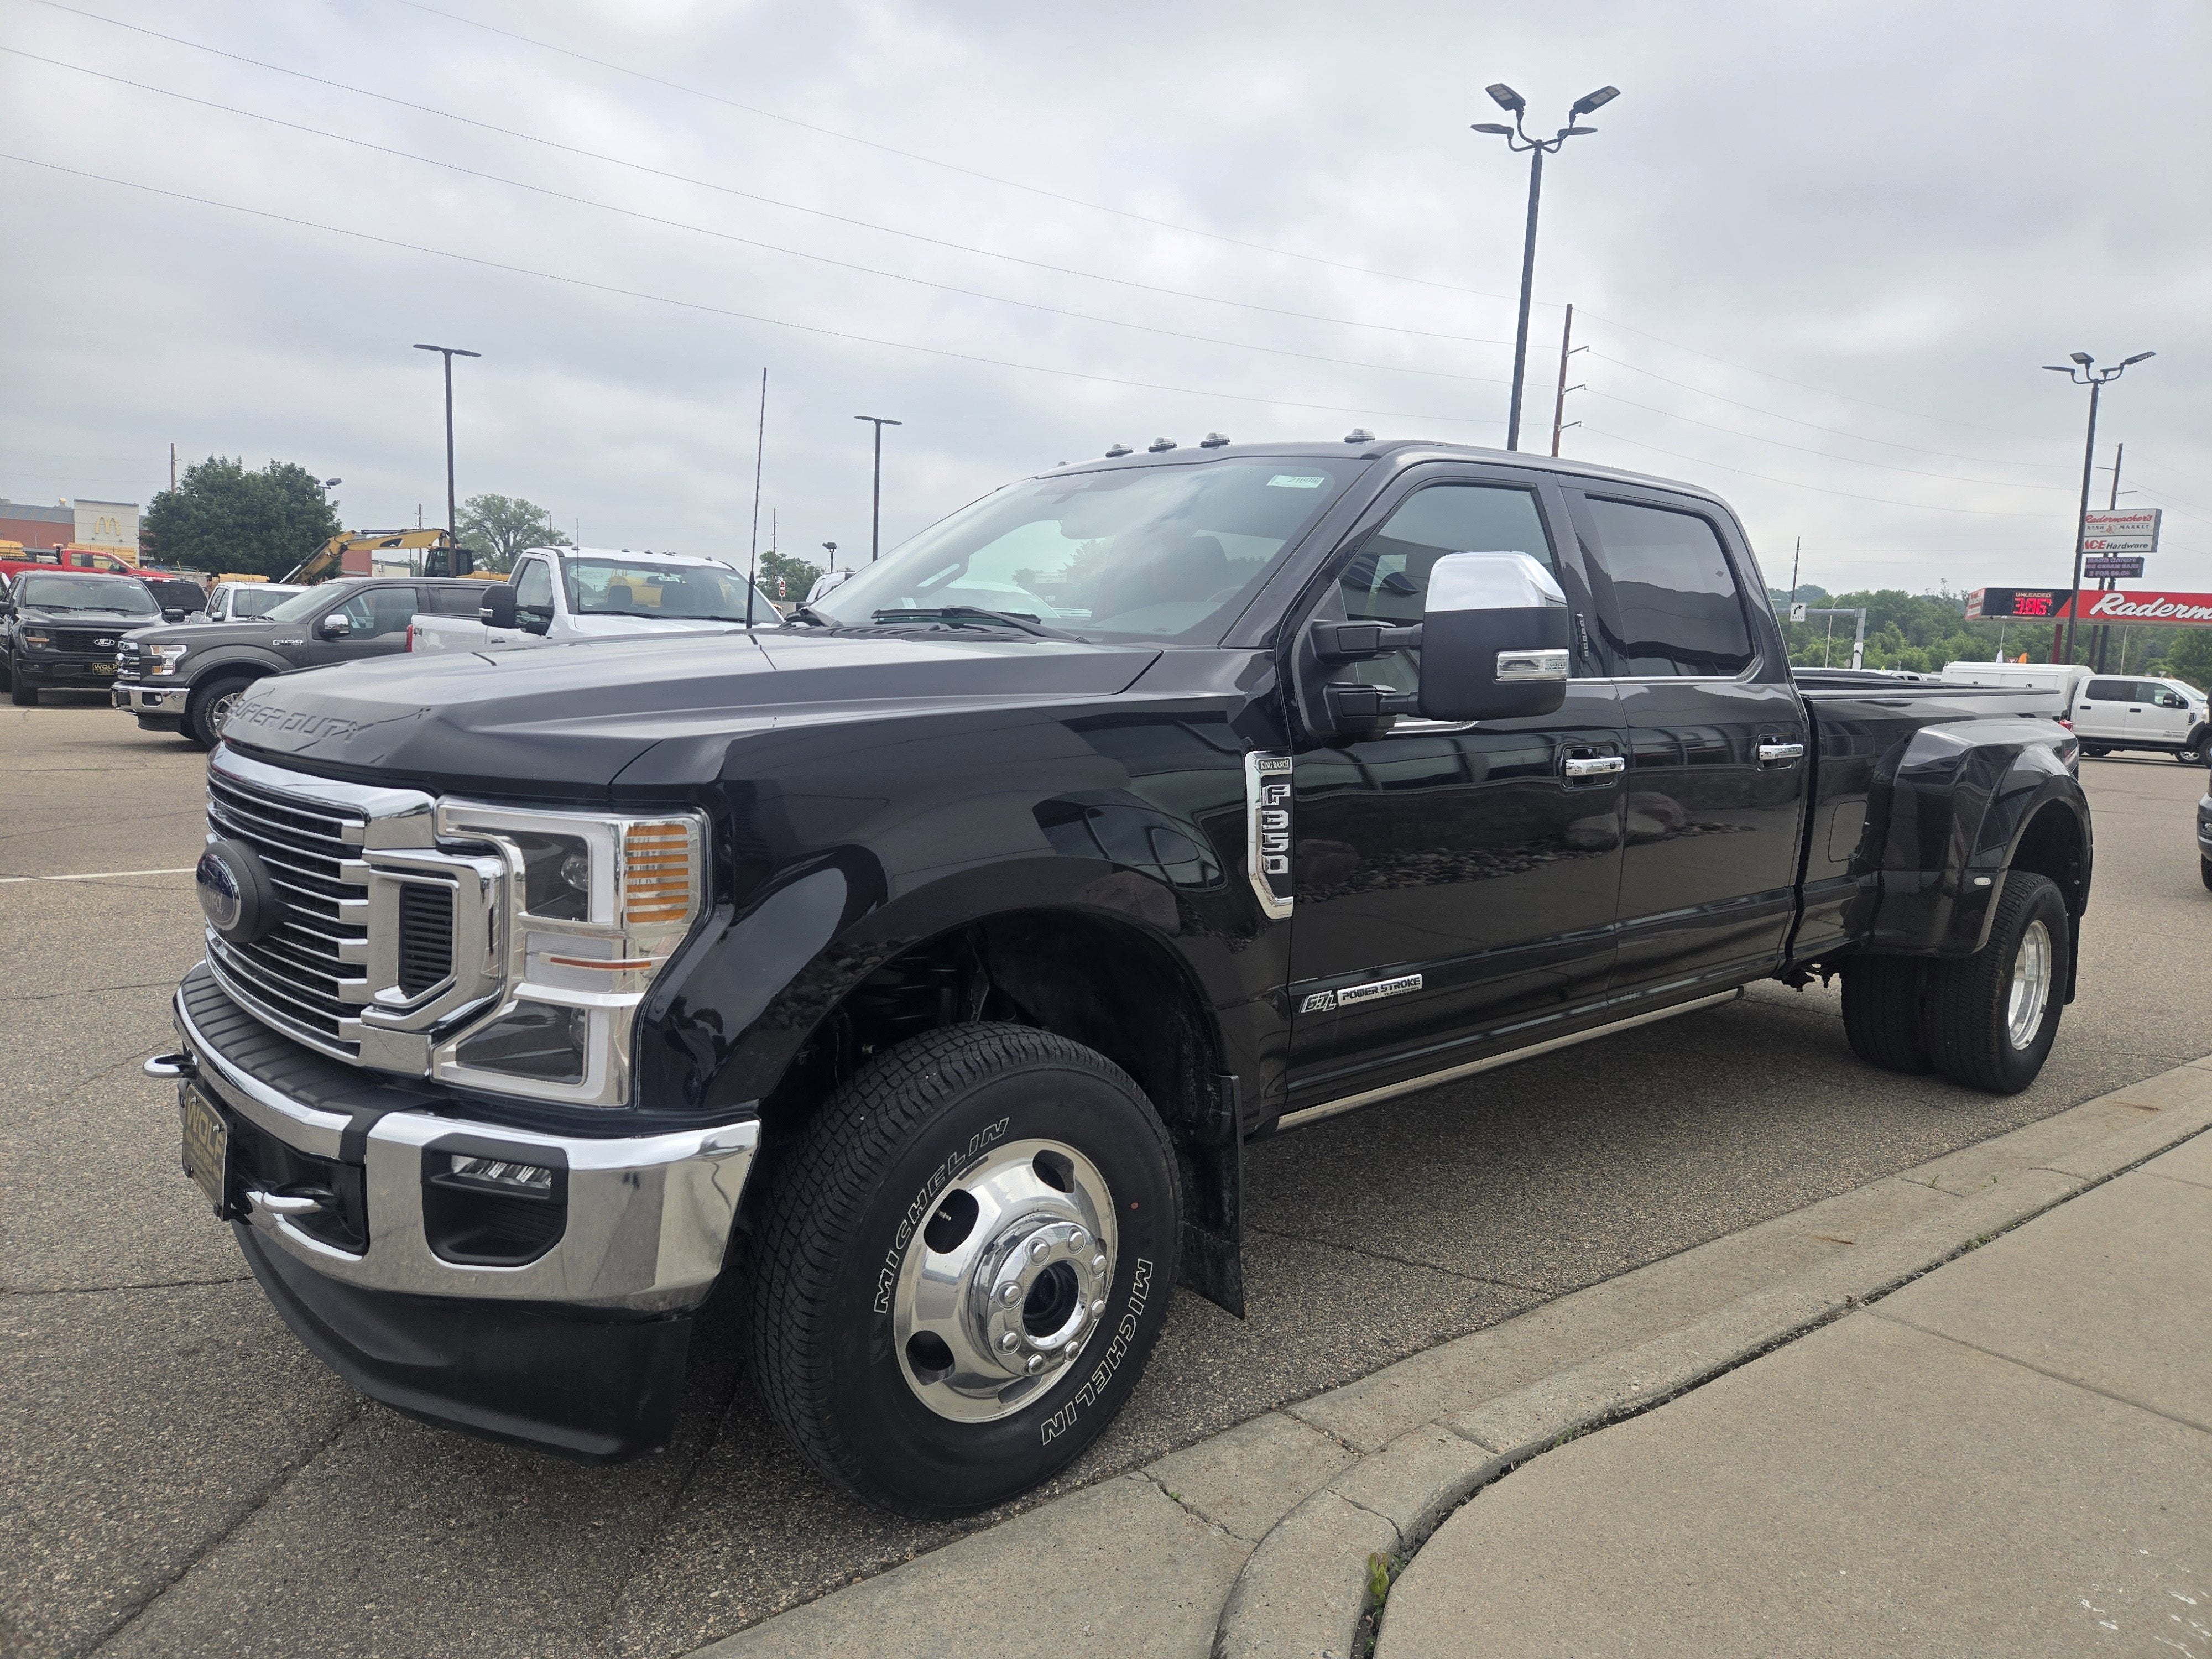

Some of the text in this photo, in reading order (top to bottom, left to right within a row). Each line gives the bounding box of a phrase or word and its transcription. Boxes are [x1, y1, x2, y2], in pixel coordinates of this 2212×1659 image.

[2085, 514, 2153, 523] Radermacher's
[279, 713, 357, 744] DUTY
[1273, 760, 1289, 768] RANCH
[1301, 977, 1421, 1013] 6.7L POWER STROKE
[186, 1095, 224, 1160] WOLF
[193, 1137, 213, 1172] MOTORS
[874, 1117, 1010, 1314] MICHELIN
[1041, 1258, 1154, 1446] MICHELIN
